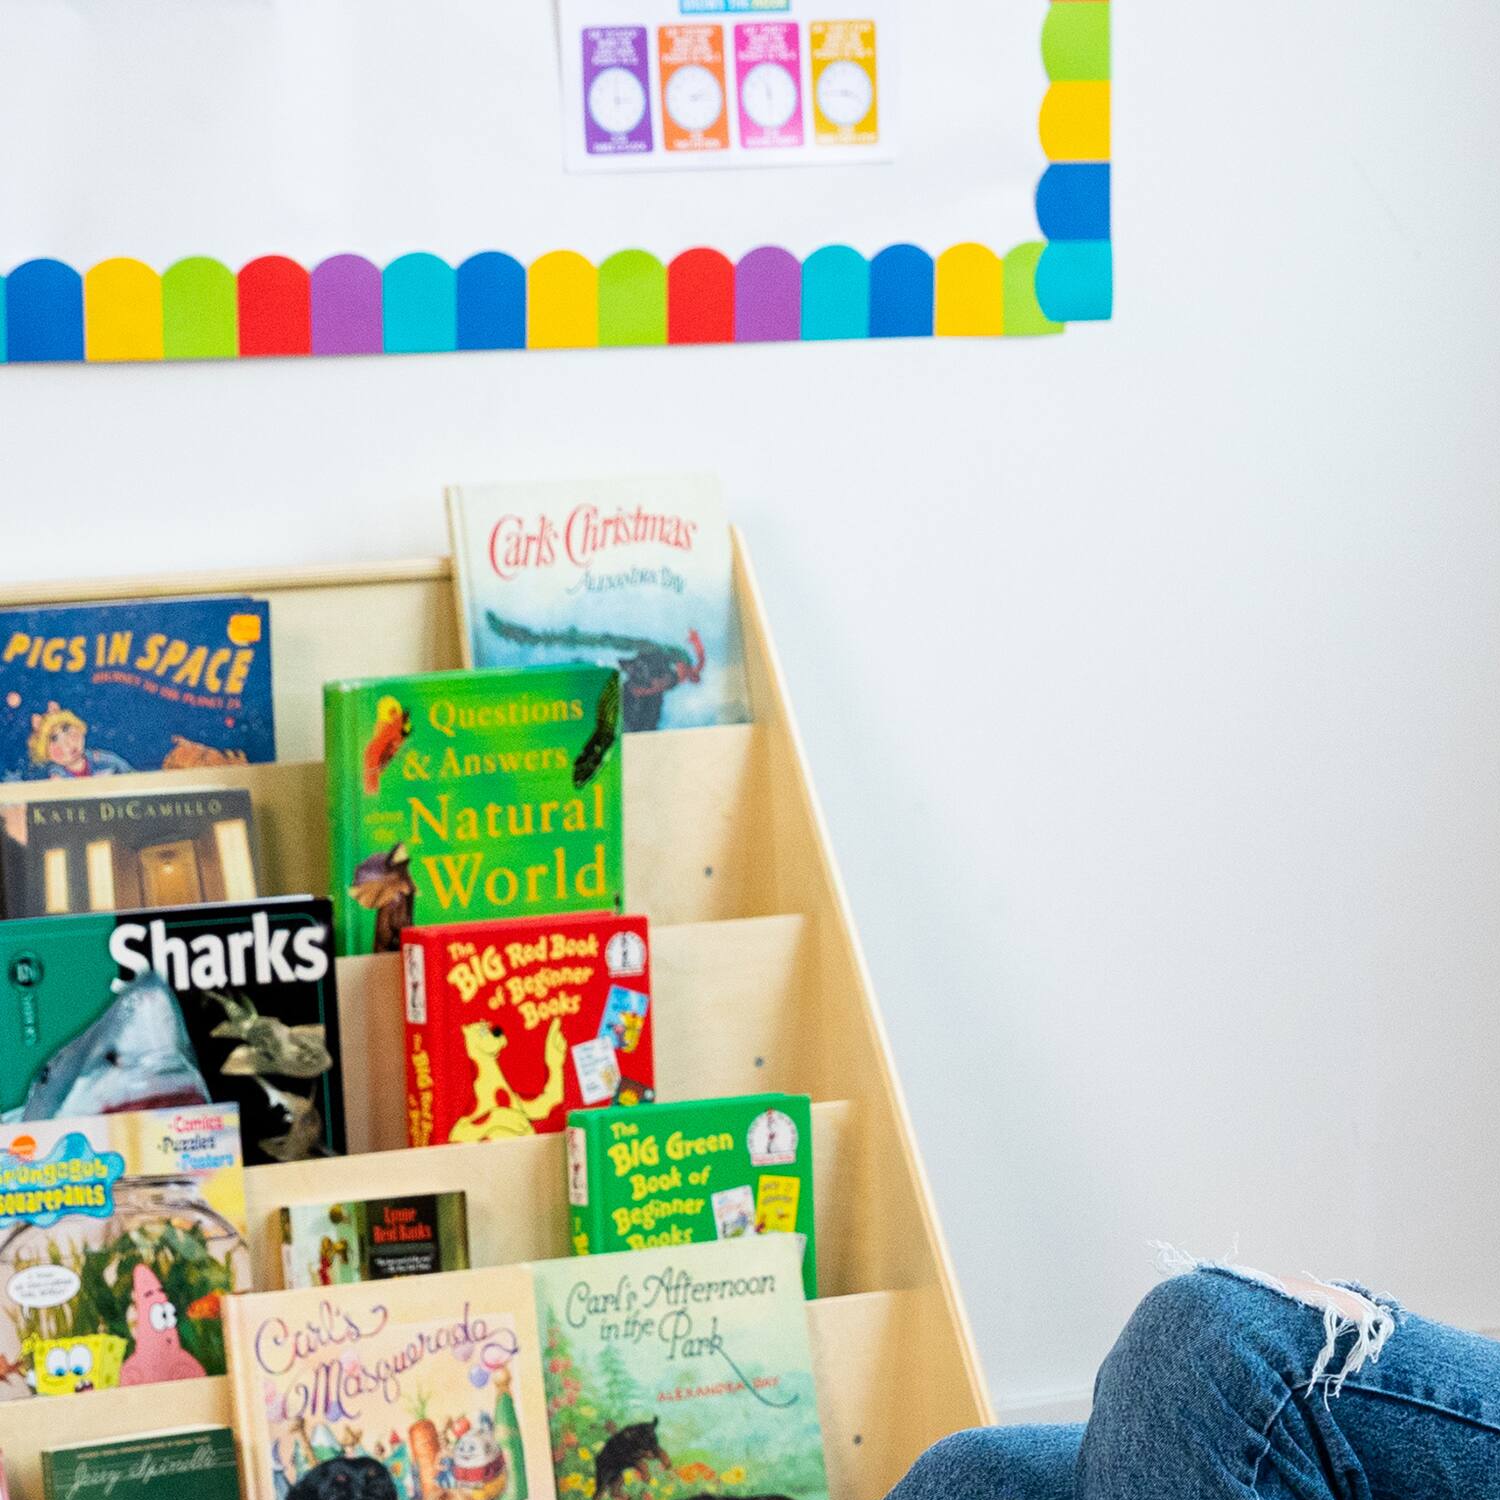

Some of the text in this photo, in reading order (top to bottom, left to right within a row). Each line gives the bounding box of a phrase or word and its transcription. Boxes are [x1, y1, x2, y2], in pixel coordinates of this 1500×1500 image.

[565, 502, 697, 568] Christmas
[3, 632, 87, 673] PIGS
[95, 630, 133, 667] IN
[135, 633, 255, 694] SPACE
[428, 694, 584, 737] Questions
[402, 747, 569, 781] & Answers
[33, 807, 85, 825] KATE
[408, 783, 605, 845] Natural
[421, 843, 607, 910] World
[109, 911, 329, 995] Sharks
[447, 942, 477, 962] The
[447, 945, 506, 1003] BIG
[505, 936, 548, 969] Red
[549, 932, 600, 961] Book
[488, 967, 595, 1010] of Beginner
[517, 991, 583, 1030] Books
[607, 1136, 660, 1177] BIG
[665, 1131, 735, 1160] Green
[609, 1122, 639, 1140] The
[630, 1165, 712, 1201] Book of
[612, 1198, 705, 1236] Beginner
[566, 1266, 776, 1329] Carl's Afternoon
[255, 1299, 388, 1375] Carl's
[600, 1306, 724, 1361] in the Park
[281, 1302, 519, 1421] Masquerade
